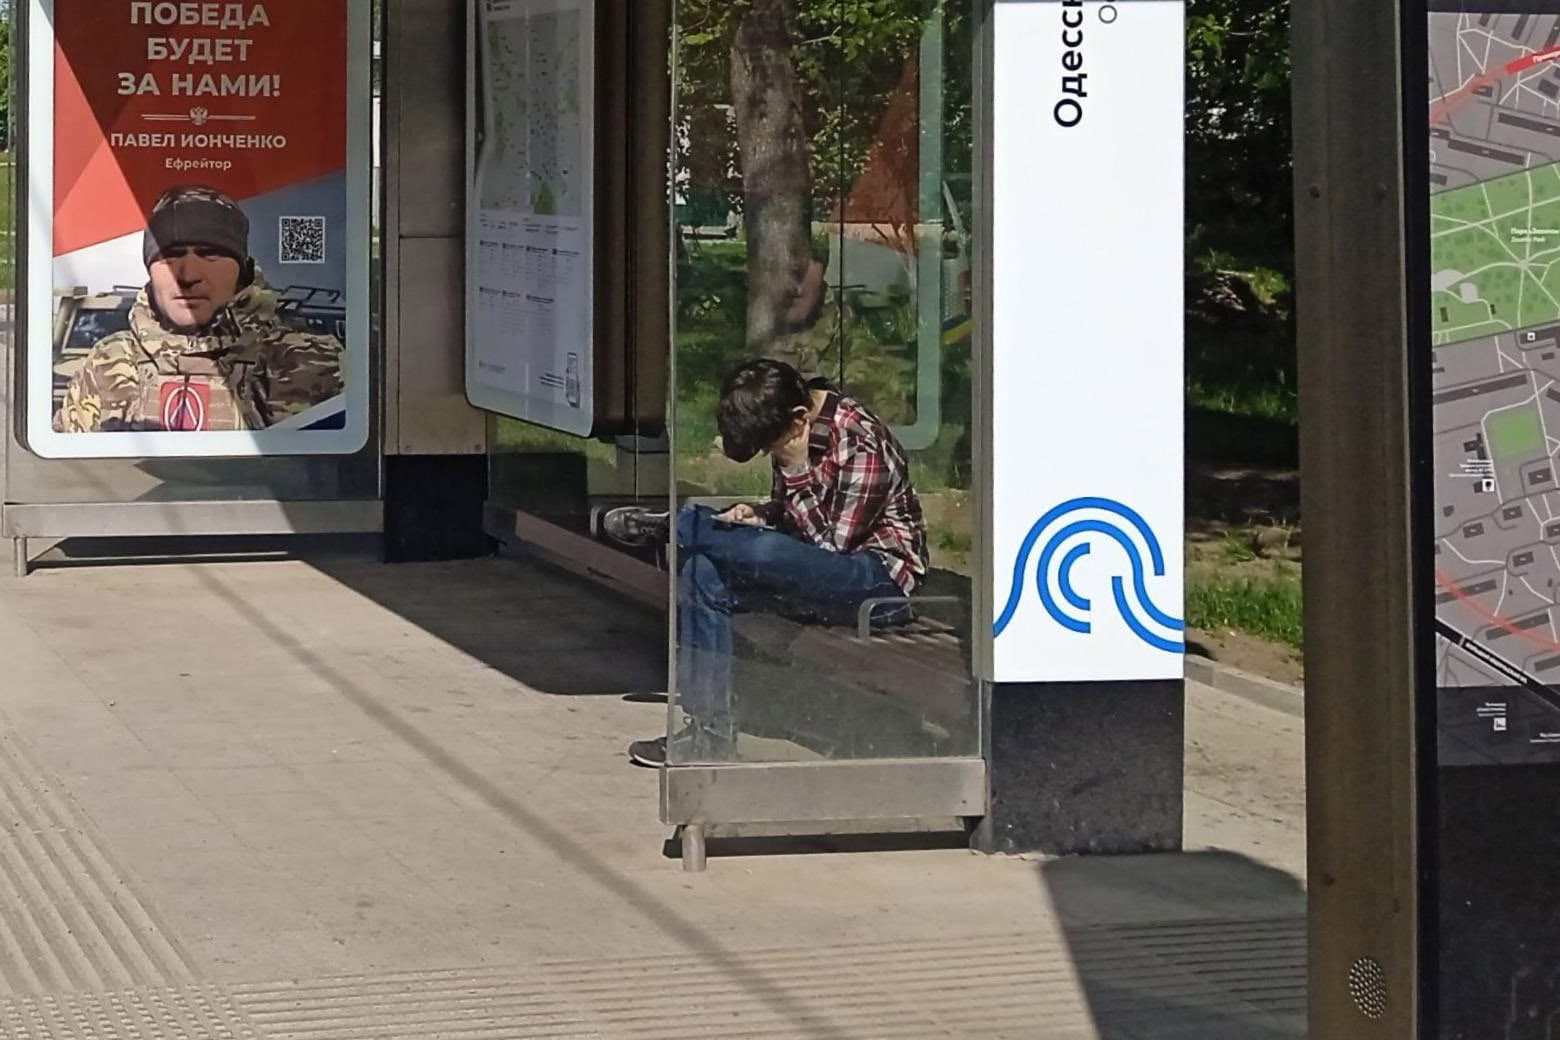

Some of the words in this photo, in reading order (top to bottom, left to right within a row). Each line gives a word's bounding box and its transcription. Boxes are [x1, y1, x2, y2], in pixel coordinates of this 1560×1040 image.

[130, 1, 271, 30] ПОБЕДА
[147, 37, 254, 65] БУДЕТ
[117, 72, 161, 96] ЗА
[171, 73, 281, 97] НАМИ!
[110, 132, 175, 148] ПАВЕЛ
[181, 134, 287, 149] ИОНЧЕНКО
[165, 157, 232, 171] Ефрейтор
